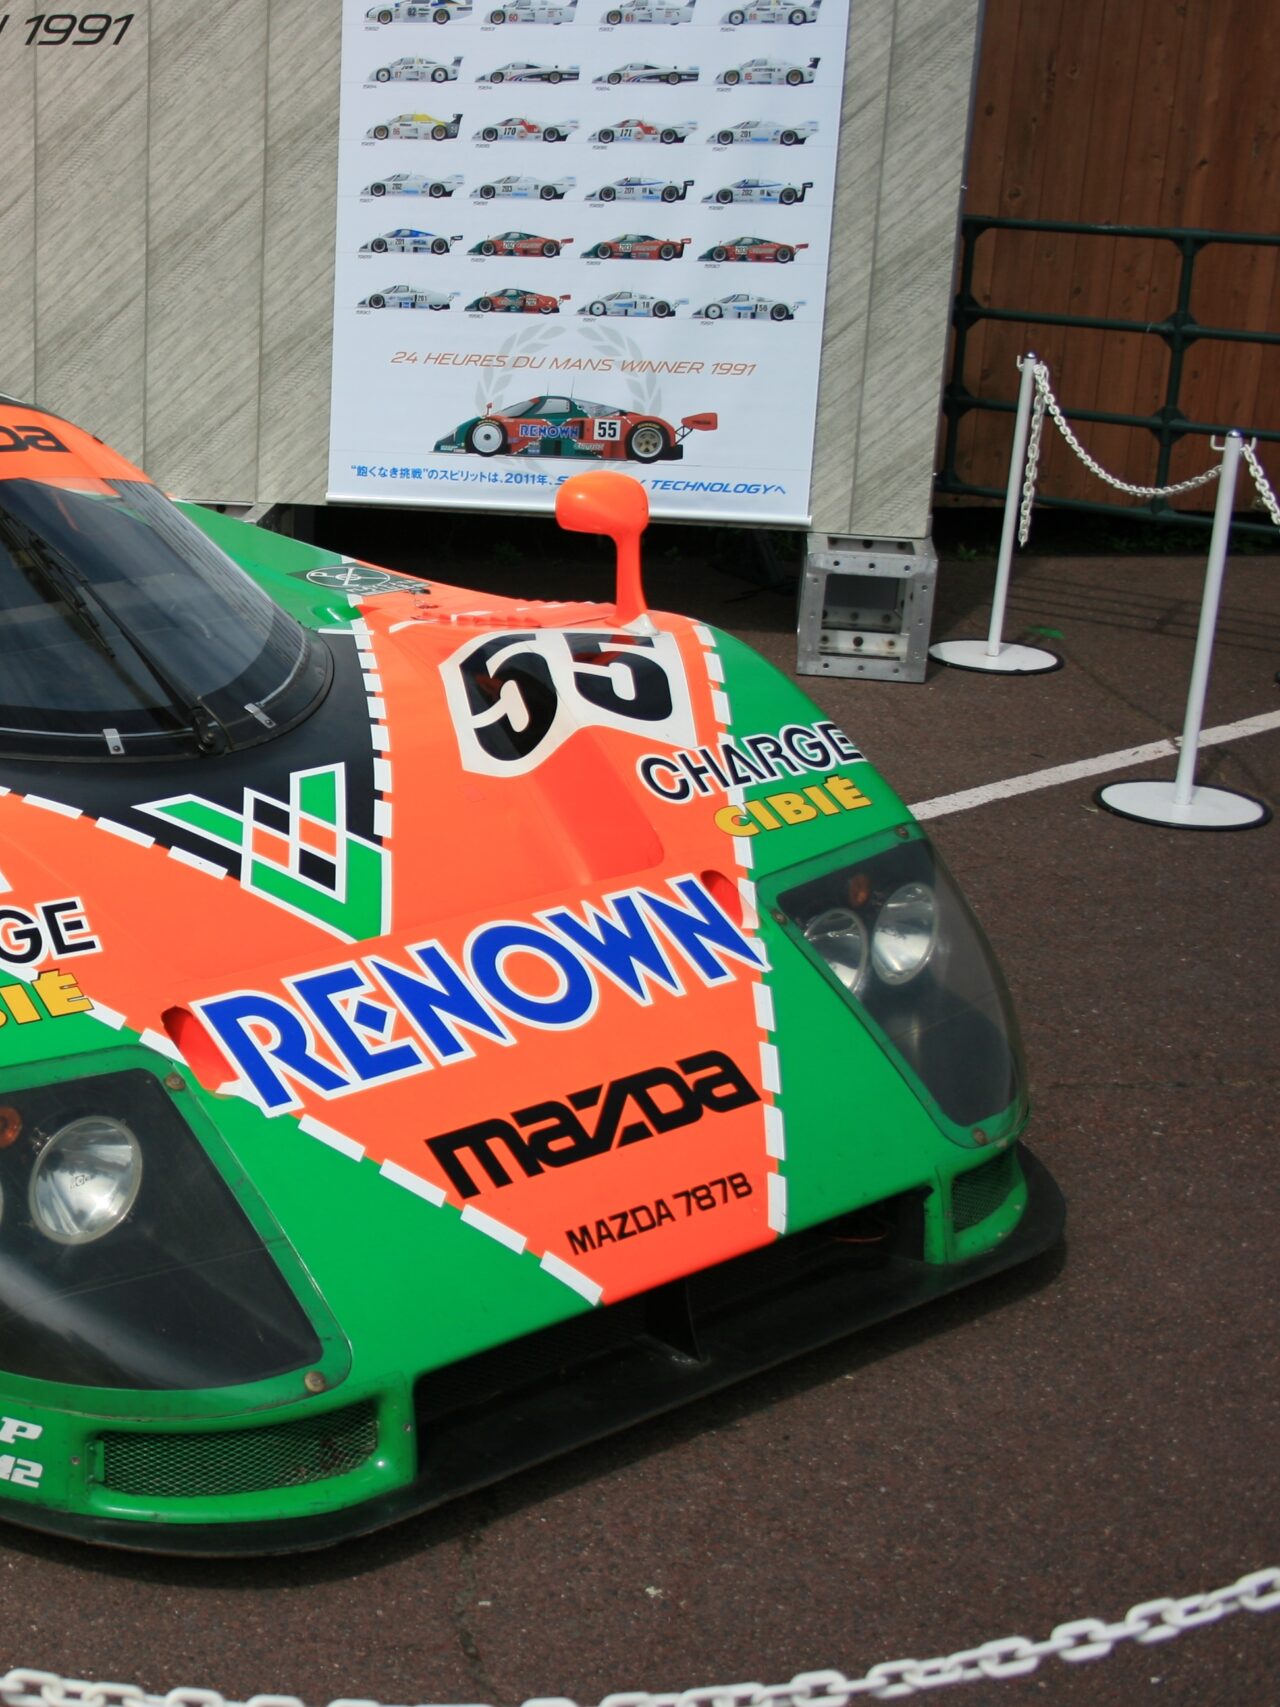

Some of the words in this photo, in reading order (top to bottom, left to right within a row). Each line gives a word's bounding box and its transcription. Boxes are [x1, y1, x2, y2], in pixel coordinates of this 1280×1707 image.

[25, 14, 134, 46] 1991
[391, 351, 418, 364] 24
[424, 352, 507, 368] HEURES
[512, 356, 546, 369] DU
[549, 357, 615, 371] MANS
[621, 359, 705, 375] WINNER
[711, 362, 757, 376] 1991
[519, 423, 581, 439] RENOWN
[596, 421, 617, 438] 55
[459, 632, 673, 761] 55
[637, 722, 868, 803] CHARGE
[190, 873, 772, 1117] RENOWN
[424, 1050, 762, 1199] mazda
[565, 1198, 676, 1256] MAZDA
[674, 1172, 754, 1218] 787B
